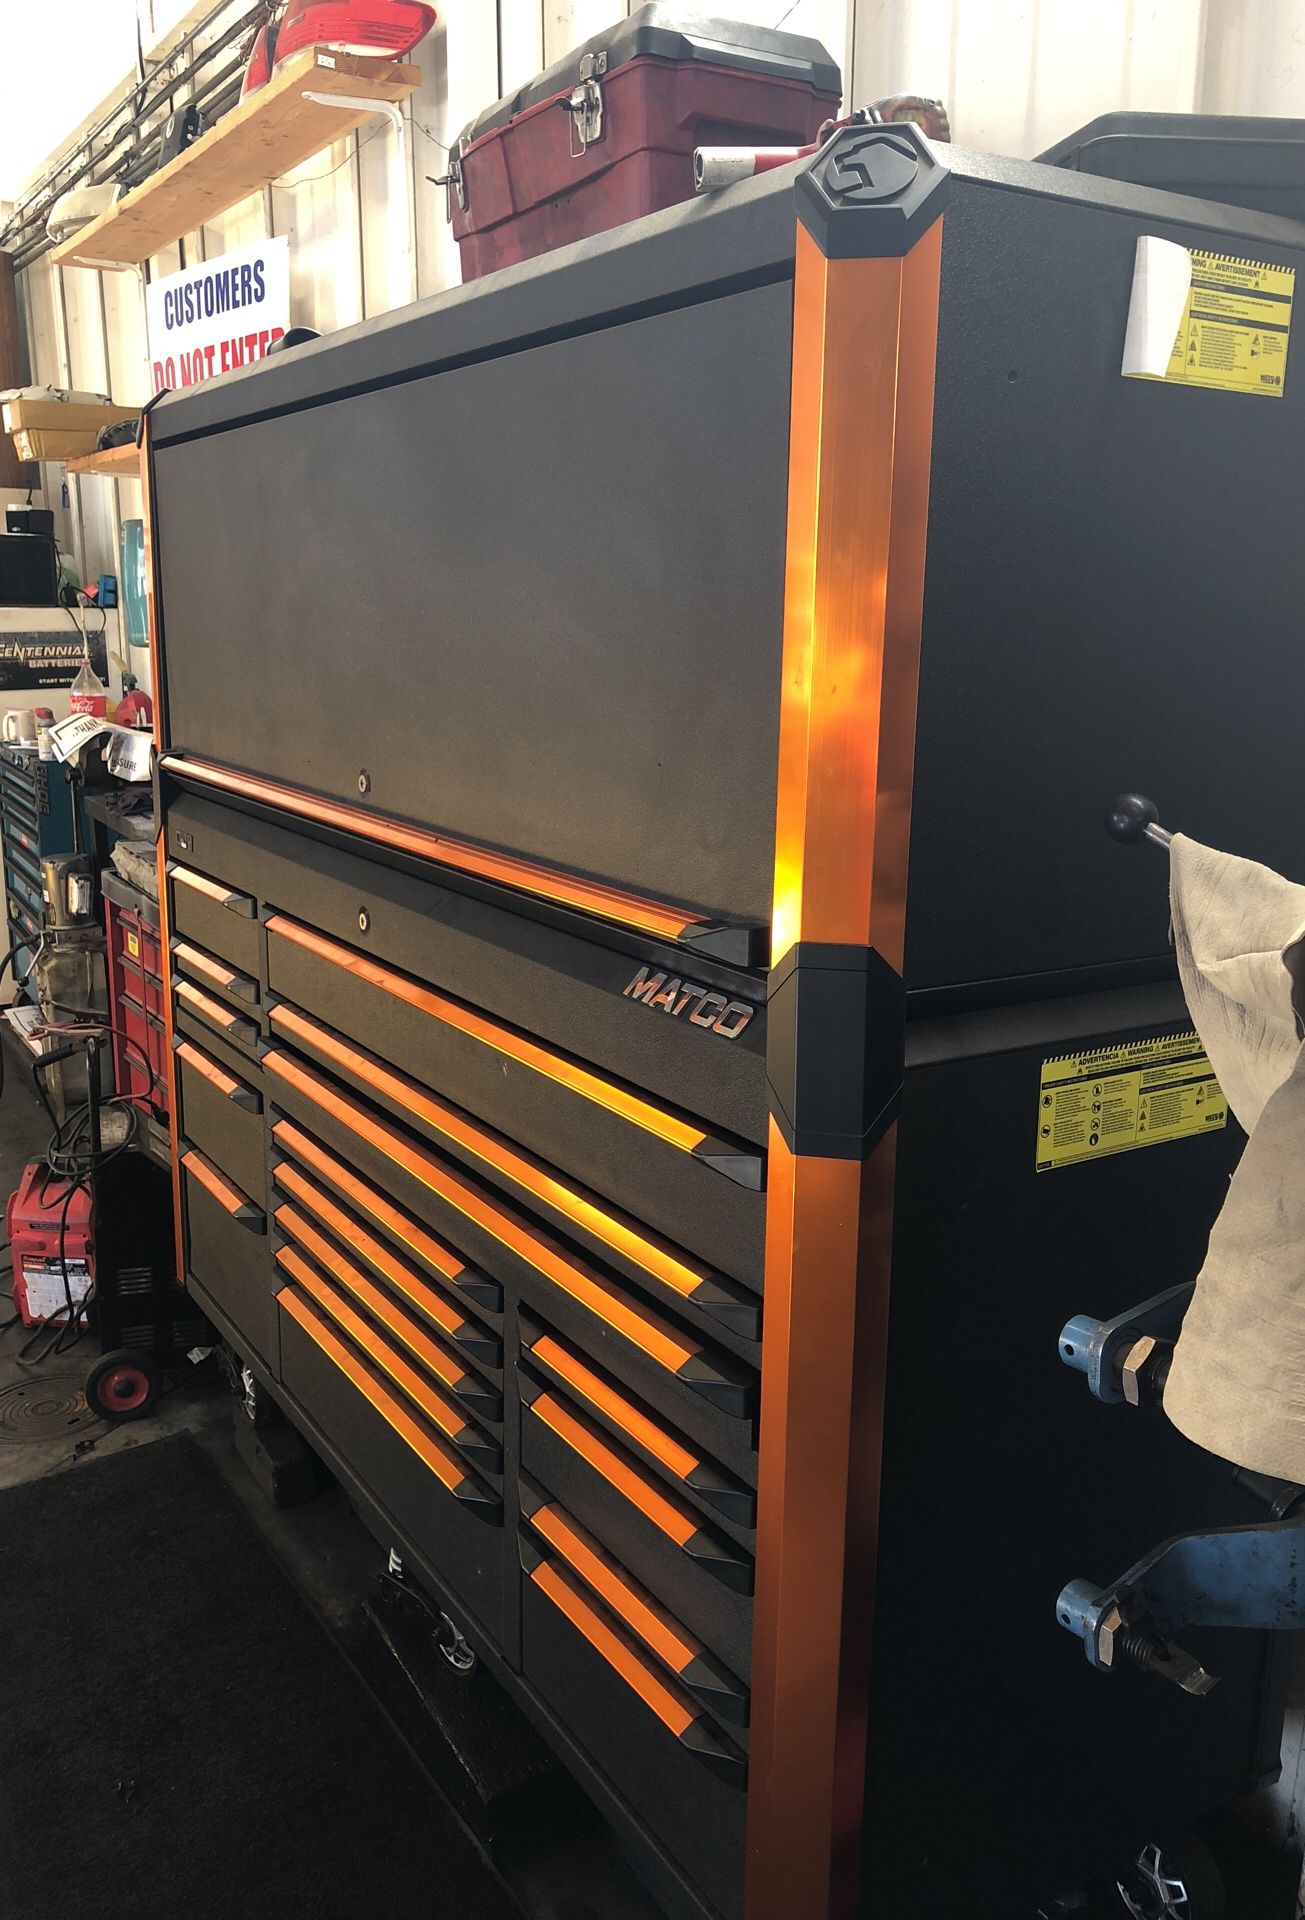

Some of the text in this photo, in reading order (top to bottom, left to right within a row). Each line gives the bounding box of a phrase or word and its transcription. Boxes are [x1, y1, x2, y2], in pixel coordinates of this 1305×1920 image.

[1192, 258, 1207, 268] NING
[164, 259, 265, 330] CUSTOMERS
[153, 356, 177, 393] DO
[180, 345, 216, 388] NOT
[29, 659, 82, 668] BATTERIE
[623, 966, 754, 1039] MATCO
[1078, 1053, 1119, 1065] ADVERTENCIA
[1127, 1046, 1154, 1056] WARNING
[1161, 1037, 1200, 1050] AVERTISSEMEN
